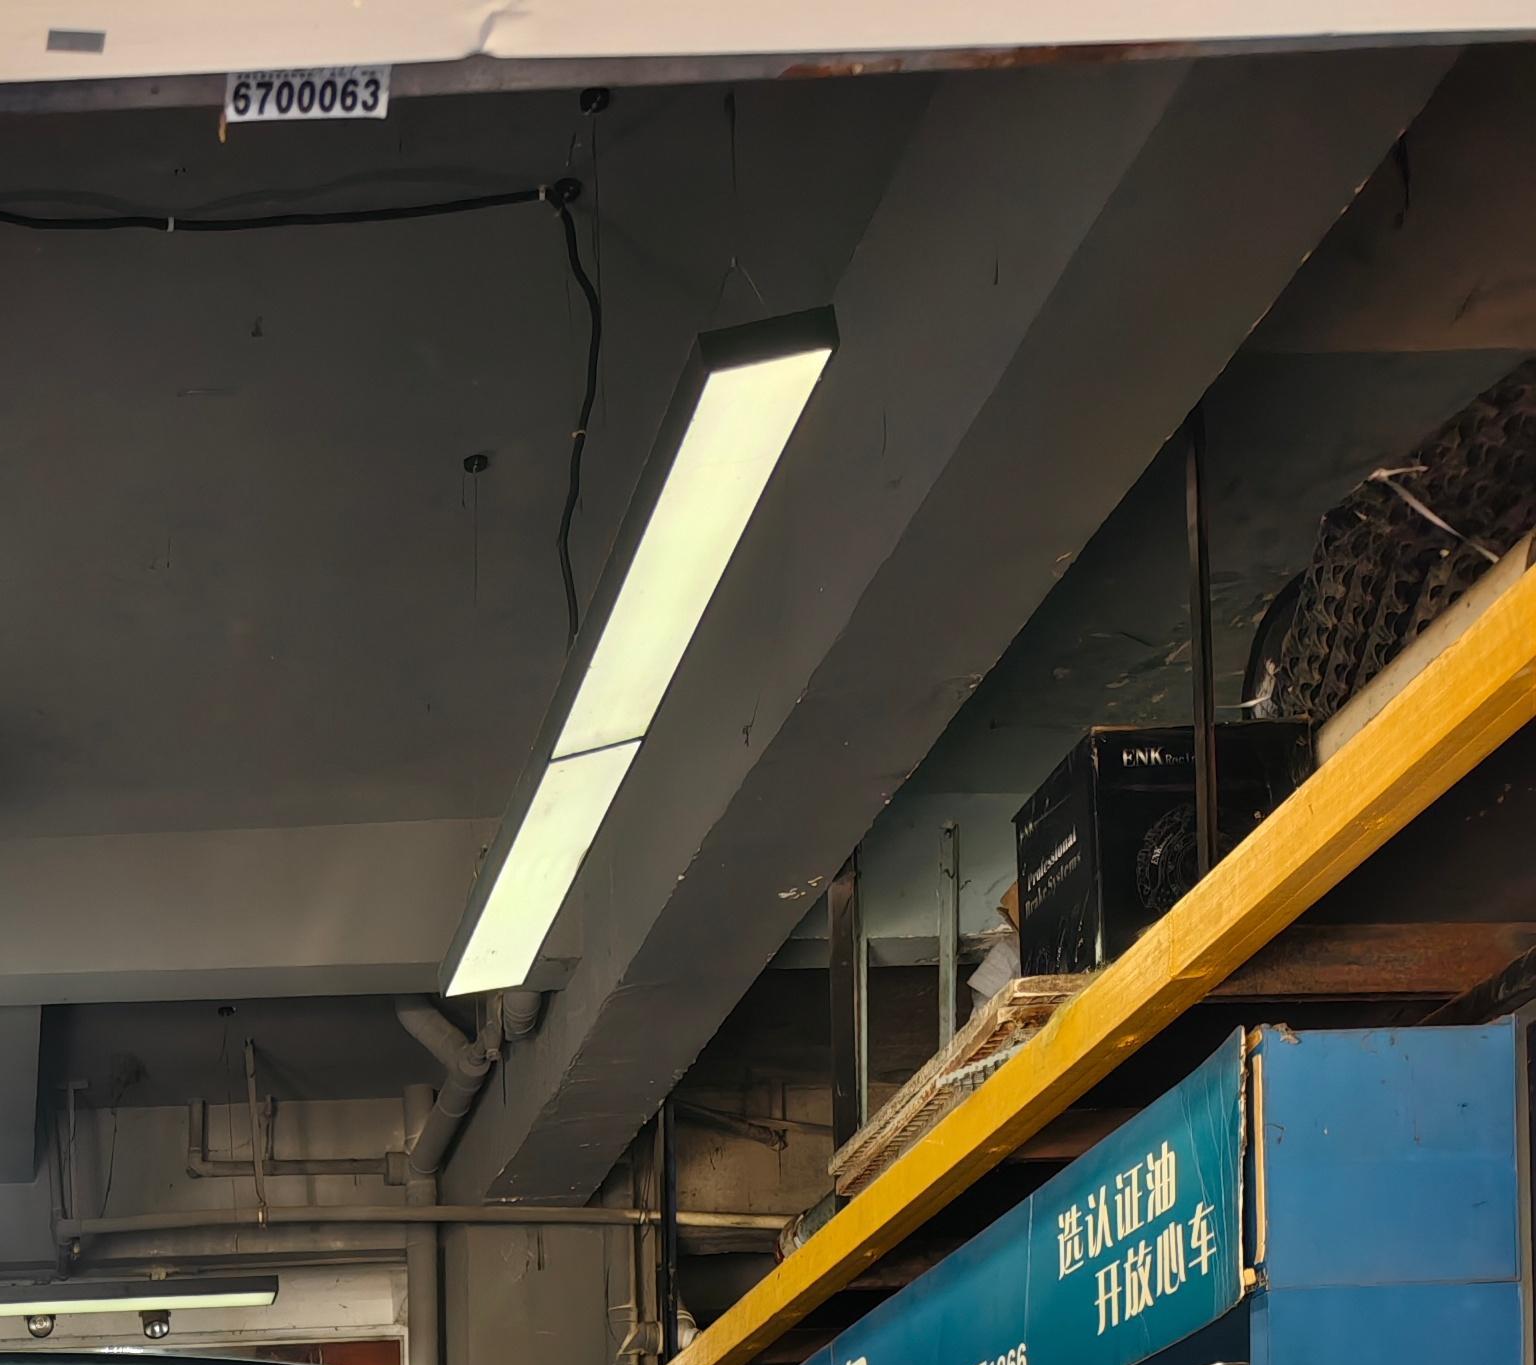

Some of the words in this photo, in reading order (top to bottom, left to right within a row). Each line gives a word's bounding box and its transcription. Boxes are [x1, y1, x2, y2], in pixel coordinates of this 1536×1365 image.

[232, 78, 382, 116] 6700063
[1121, 746, 1165, 768] ENK
[1057, 1140, 1177, 1281] 选认证油
[1094, 1201, 1217, 1336] 开放心车
